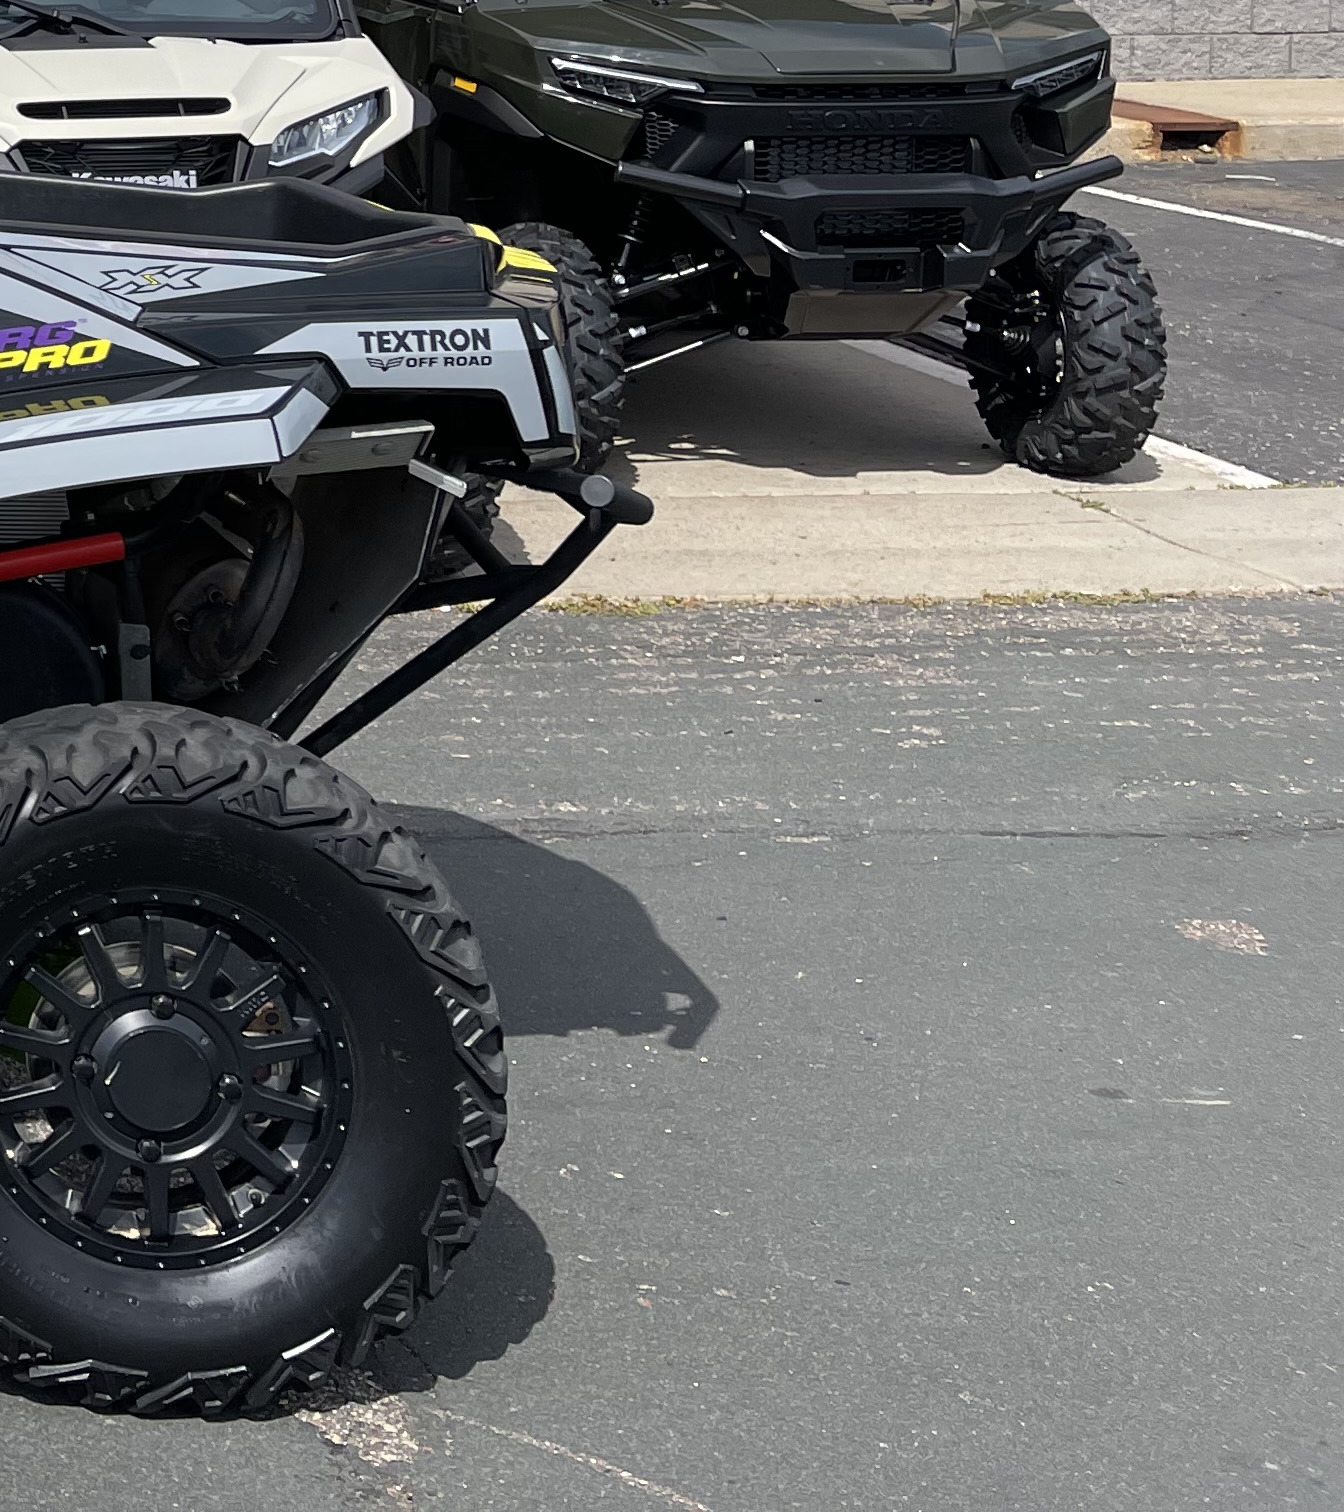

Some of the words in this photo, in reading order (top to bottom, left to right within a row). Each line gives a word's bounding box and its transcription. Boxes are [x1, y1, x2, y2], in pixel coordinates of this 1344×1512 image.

[357, 327, 492, 354] TEXTRON
[405, 356, 439, 368] OFF
[443, 355, 493, 367] ROAD
